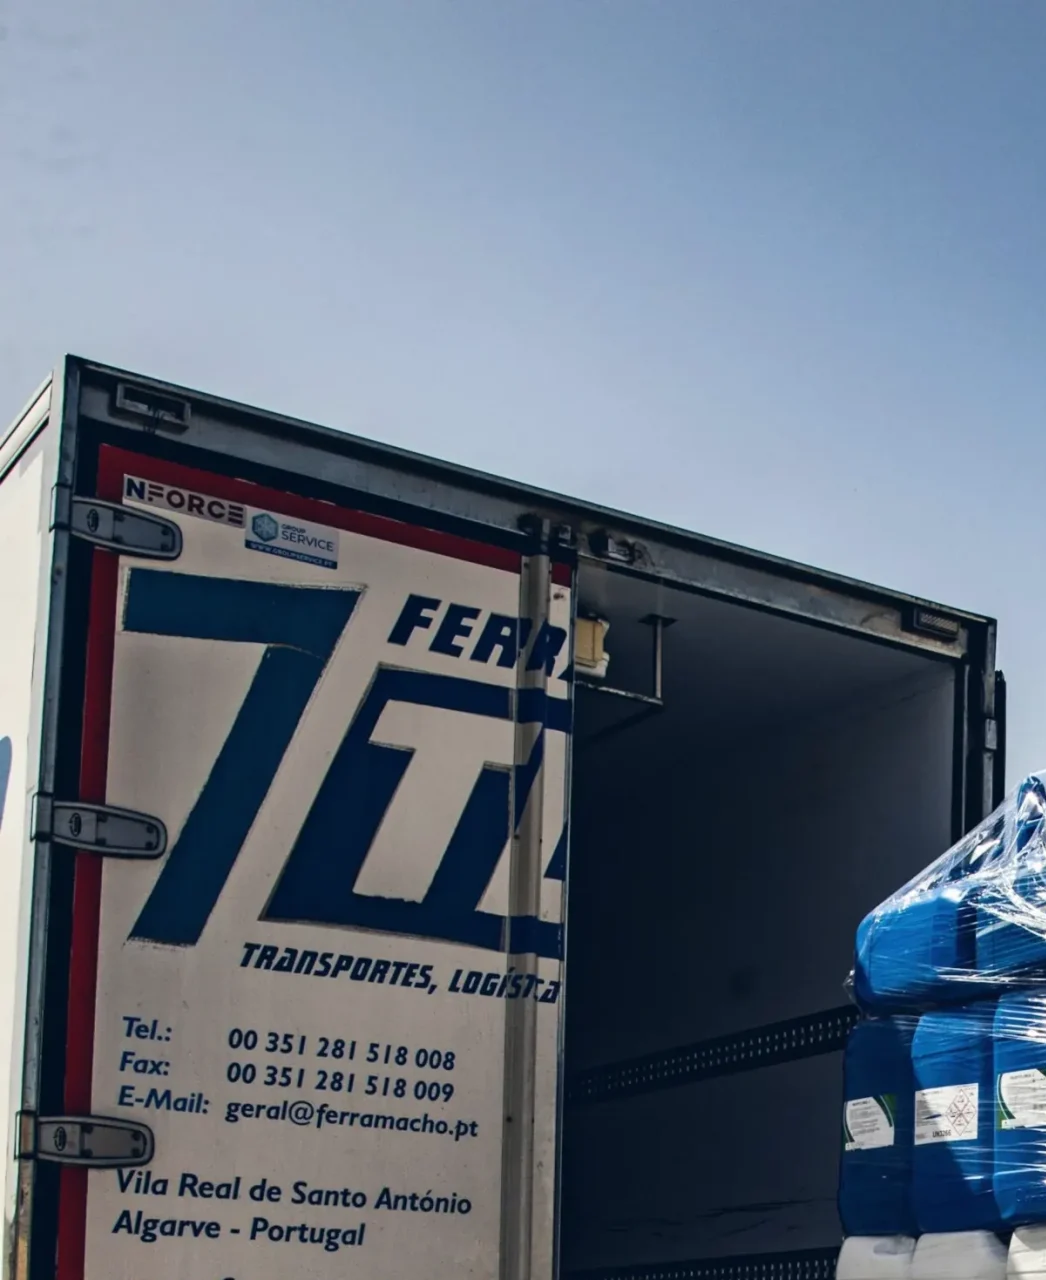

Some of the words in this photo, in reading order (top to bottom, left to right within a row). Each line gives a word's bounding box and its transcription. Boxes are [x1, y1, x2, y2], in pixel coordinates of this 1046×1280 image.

[281, 523, 306, 534] GROUP
[281, 530, 334, 552] SERVICE
[387, 593, 574, 681] FERR
[122, 1016, 172, 1042] Tel.:
[228, 1028, 258, 1050] 00
[265, 1032, 306, 1055] 351
[317, 1037, 356, 1060] 281
[366, 1043, 408, 1066] 518
[415, 1049, 455, 1070] 008
[119, 1051, 170, 1076] Fax:
[227, 1062, 256, 1084] 00
[264, 1066, 305, 1088] 351
[315, 1070, 355, 1093] 281
[365, 1075, 407, 1098] 518
[414, 1080, 454, 1102] 009
[118, 1085, 209, 1114] E-Mail:
[225, 1101, 479, 1141] geral@ferramacho.pt
[116, 1168, 169, 1196] Vila
[178, 1173, 241, 1200] Real
[249, 1179, 282, 1203] de
[291, 1181, 367, 1208] Santo
[374, 1187, 472, 1215] António
[112, 1210, 221, 1243] Algarve
[250, 1217, 366, 1251] Portugal
